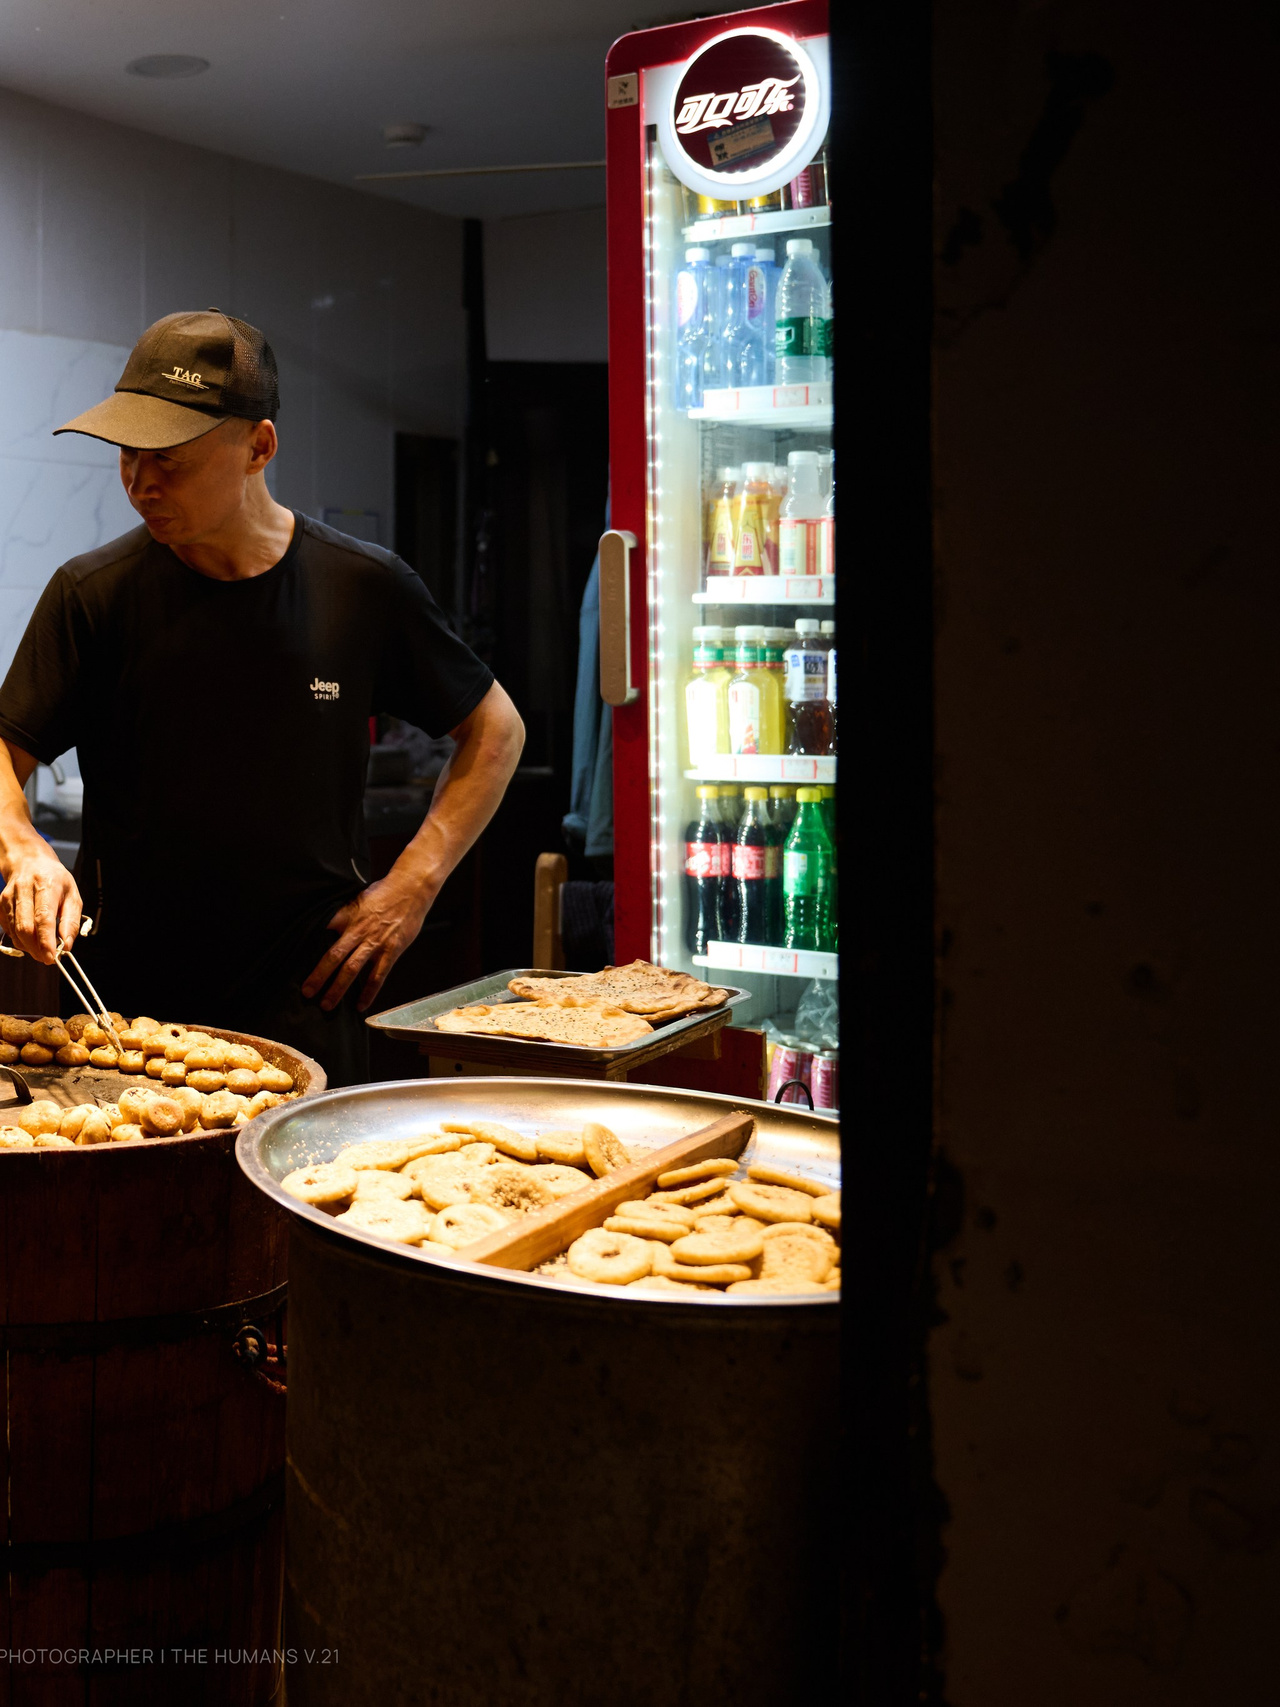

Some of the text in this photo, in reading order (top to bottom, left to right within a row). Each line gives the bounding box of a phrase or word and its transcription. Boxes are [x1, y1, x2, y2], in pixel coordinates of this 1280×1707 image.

[676, 73, 801, 134] 可口可乐
[172, 366, 201, 385] TAG
[310, 677, 340, 698] Jeep
